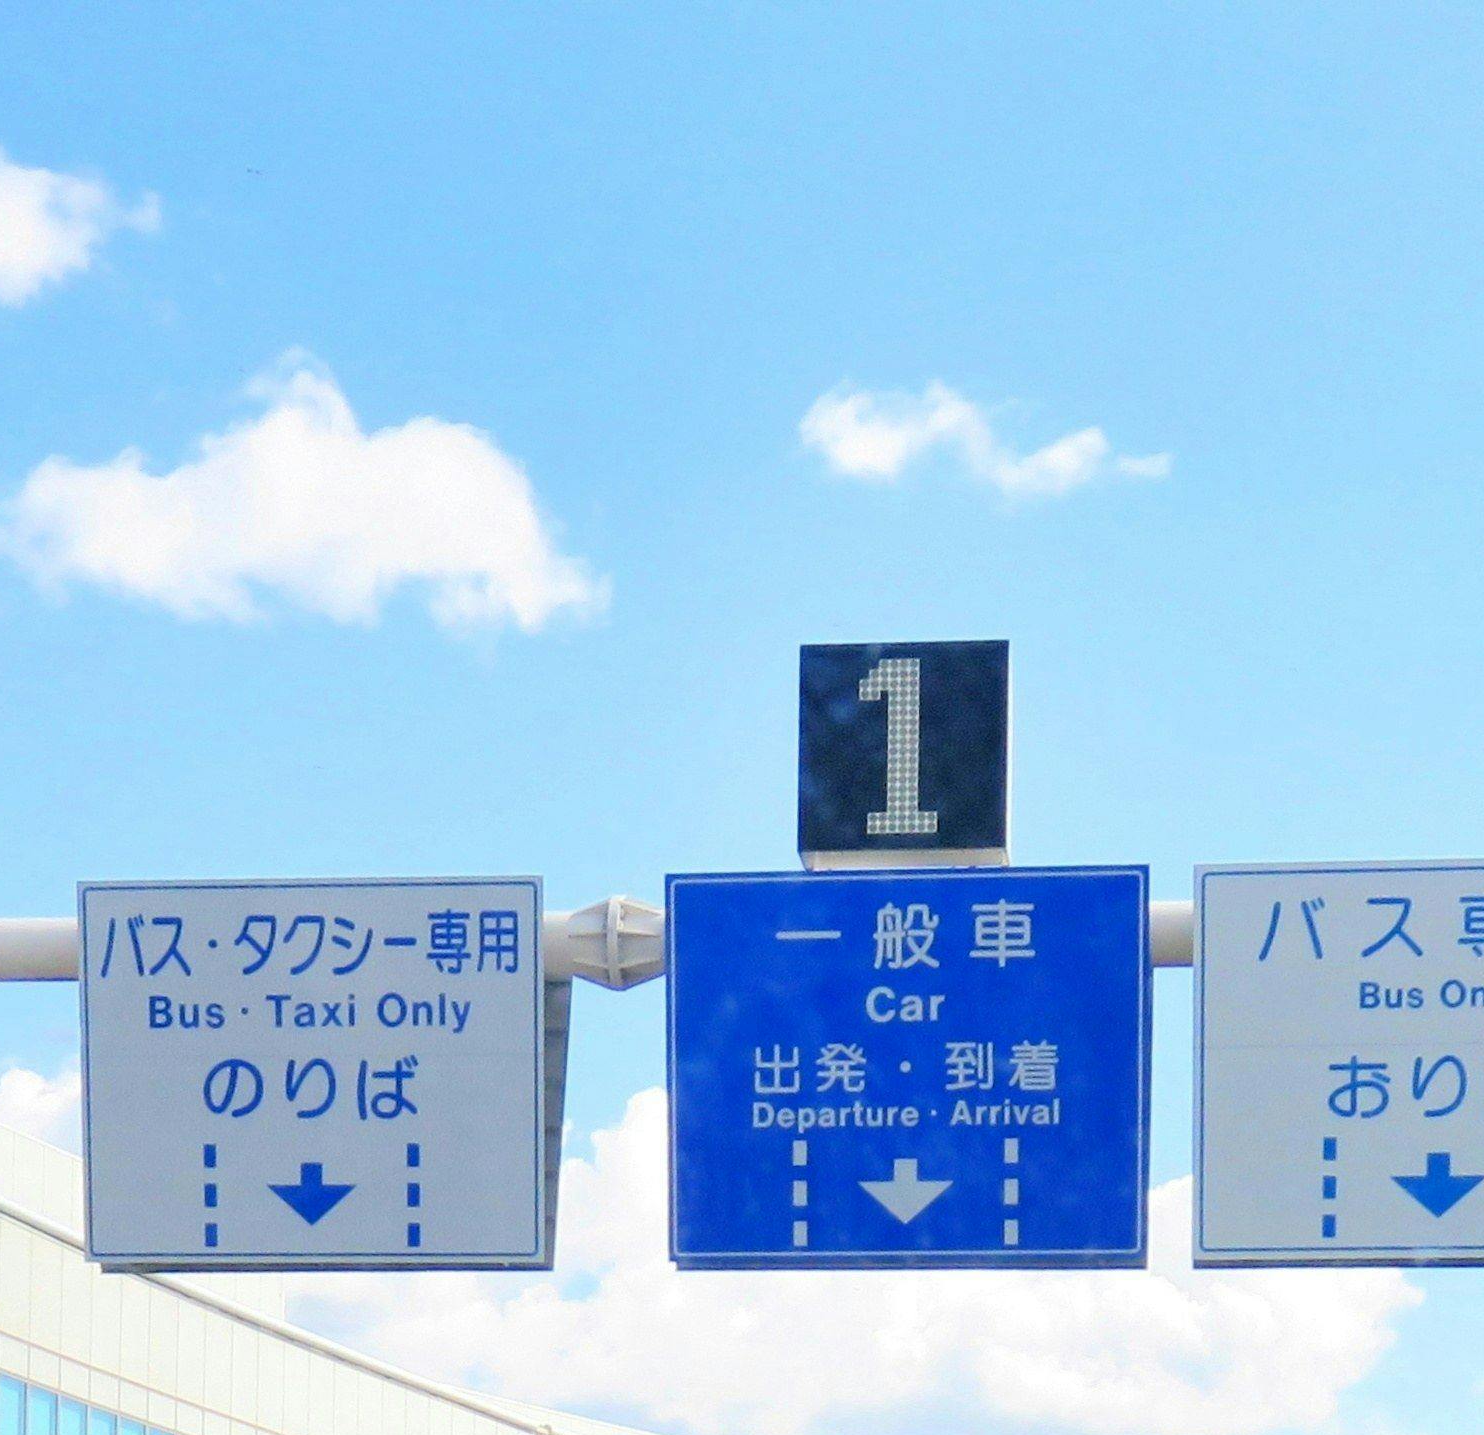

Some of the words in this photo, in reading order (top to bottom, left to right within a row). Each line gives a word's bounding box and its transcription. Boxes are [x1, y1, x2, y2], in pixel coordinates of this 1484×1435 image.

[859, 658, 938, 834] 1
[101, 908, 520, 978] バス・タクシー専用
[775, 897, 1036, 970] 一般車
[377, 993, 472, 1033] Only
[865, 986, 946, 1024] Car
[1358, 981, 1425, 1010] Bus
[203, 1055, 419, 1120] のりば
[753, 1041, 1060, 1096] 出発・到着
